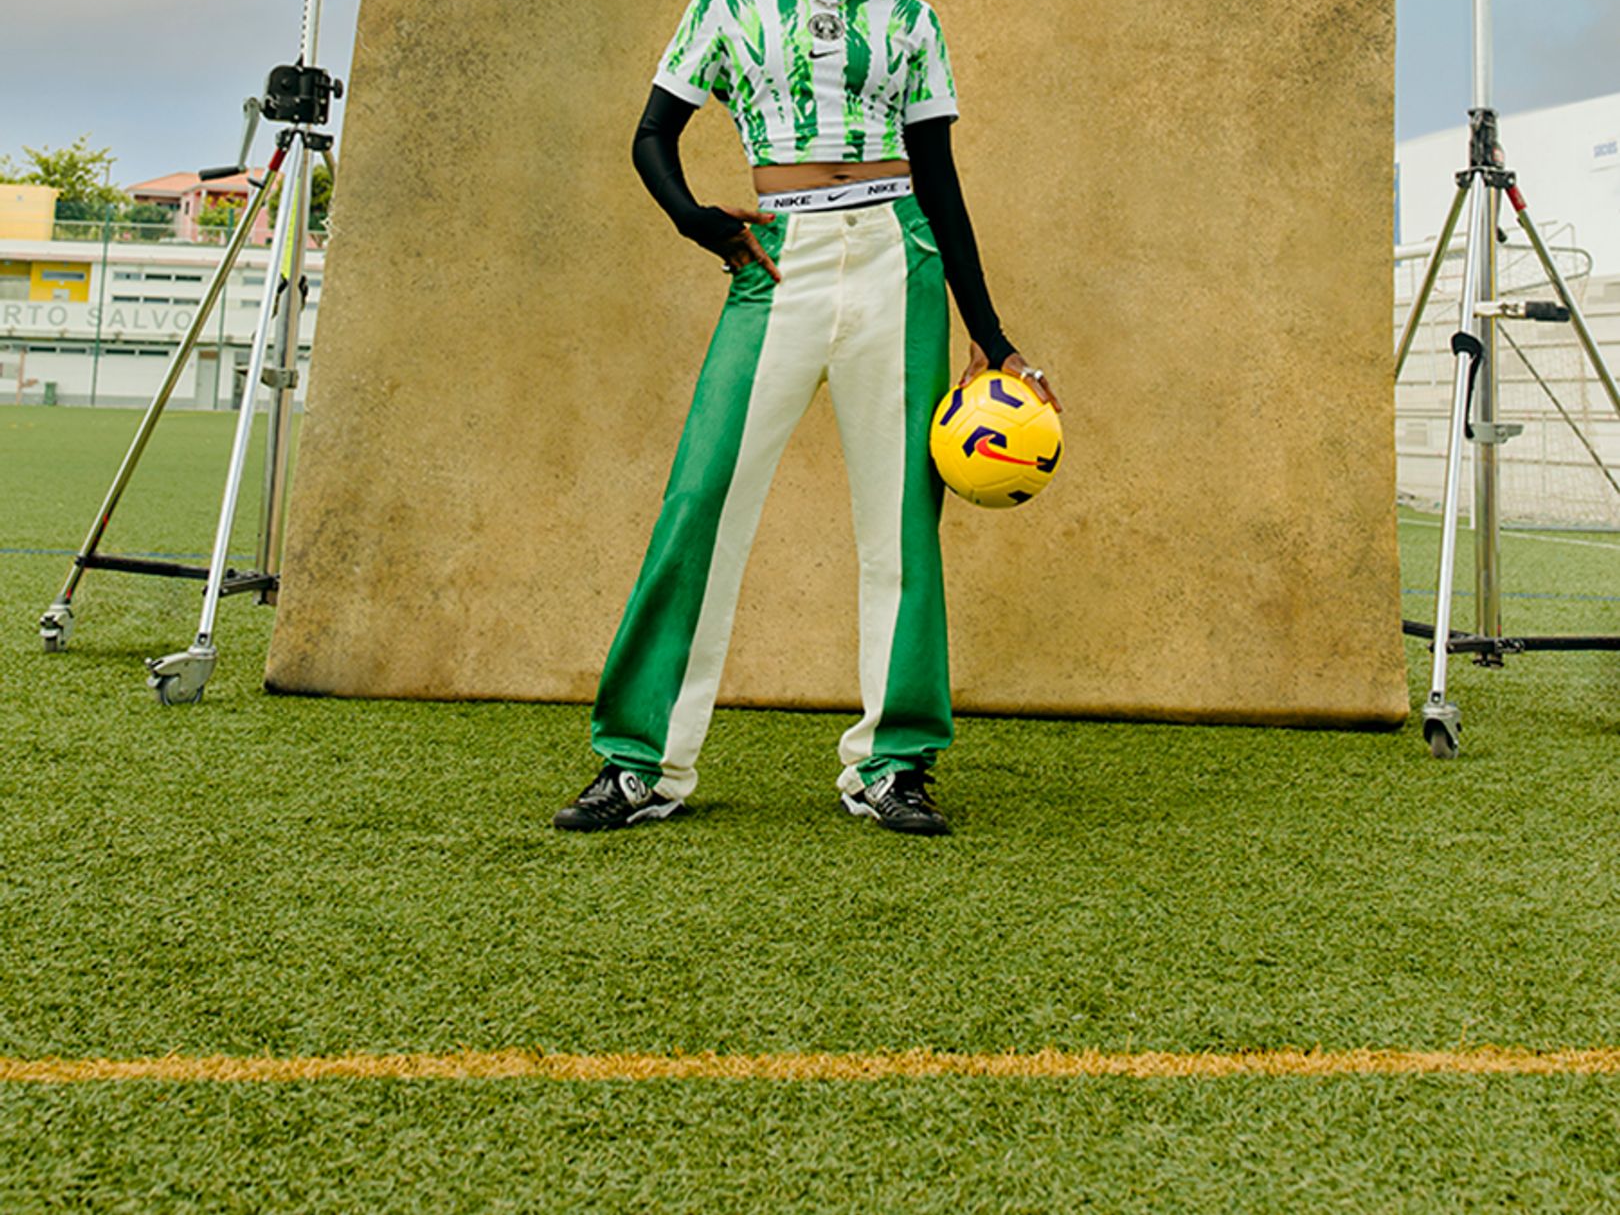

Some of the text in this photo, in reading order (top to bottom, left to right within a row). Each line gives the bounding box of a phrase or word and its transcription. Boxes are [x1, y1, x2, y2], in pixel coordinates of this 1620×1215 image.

[774, 182, 899, 208] NIKE NIKE
[86, 307, 194, 331] SALVO
